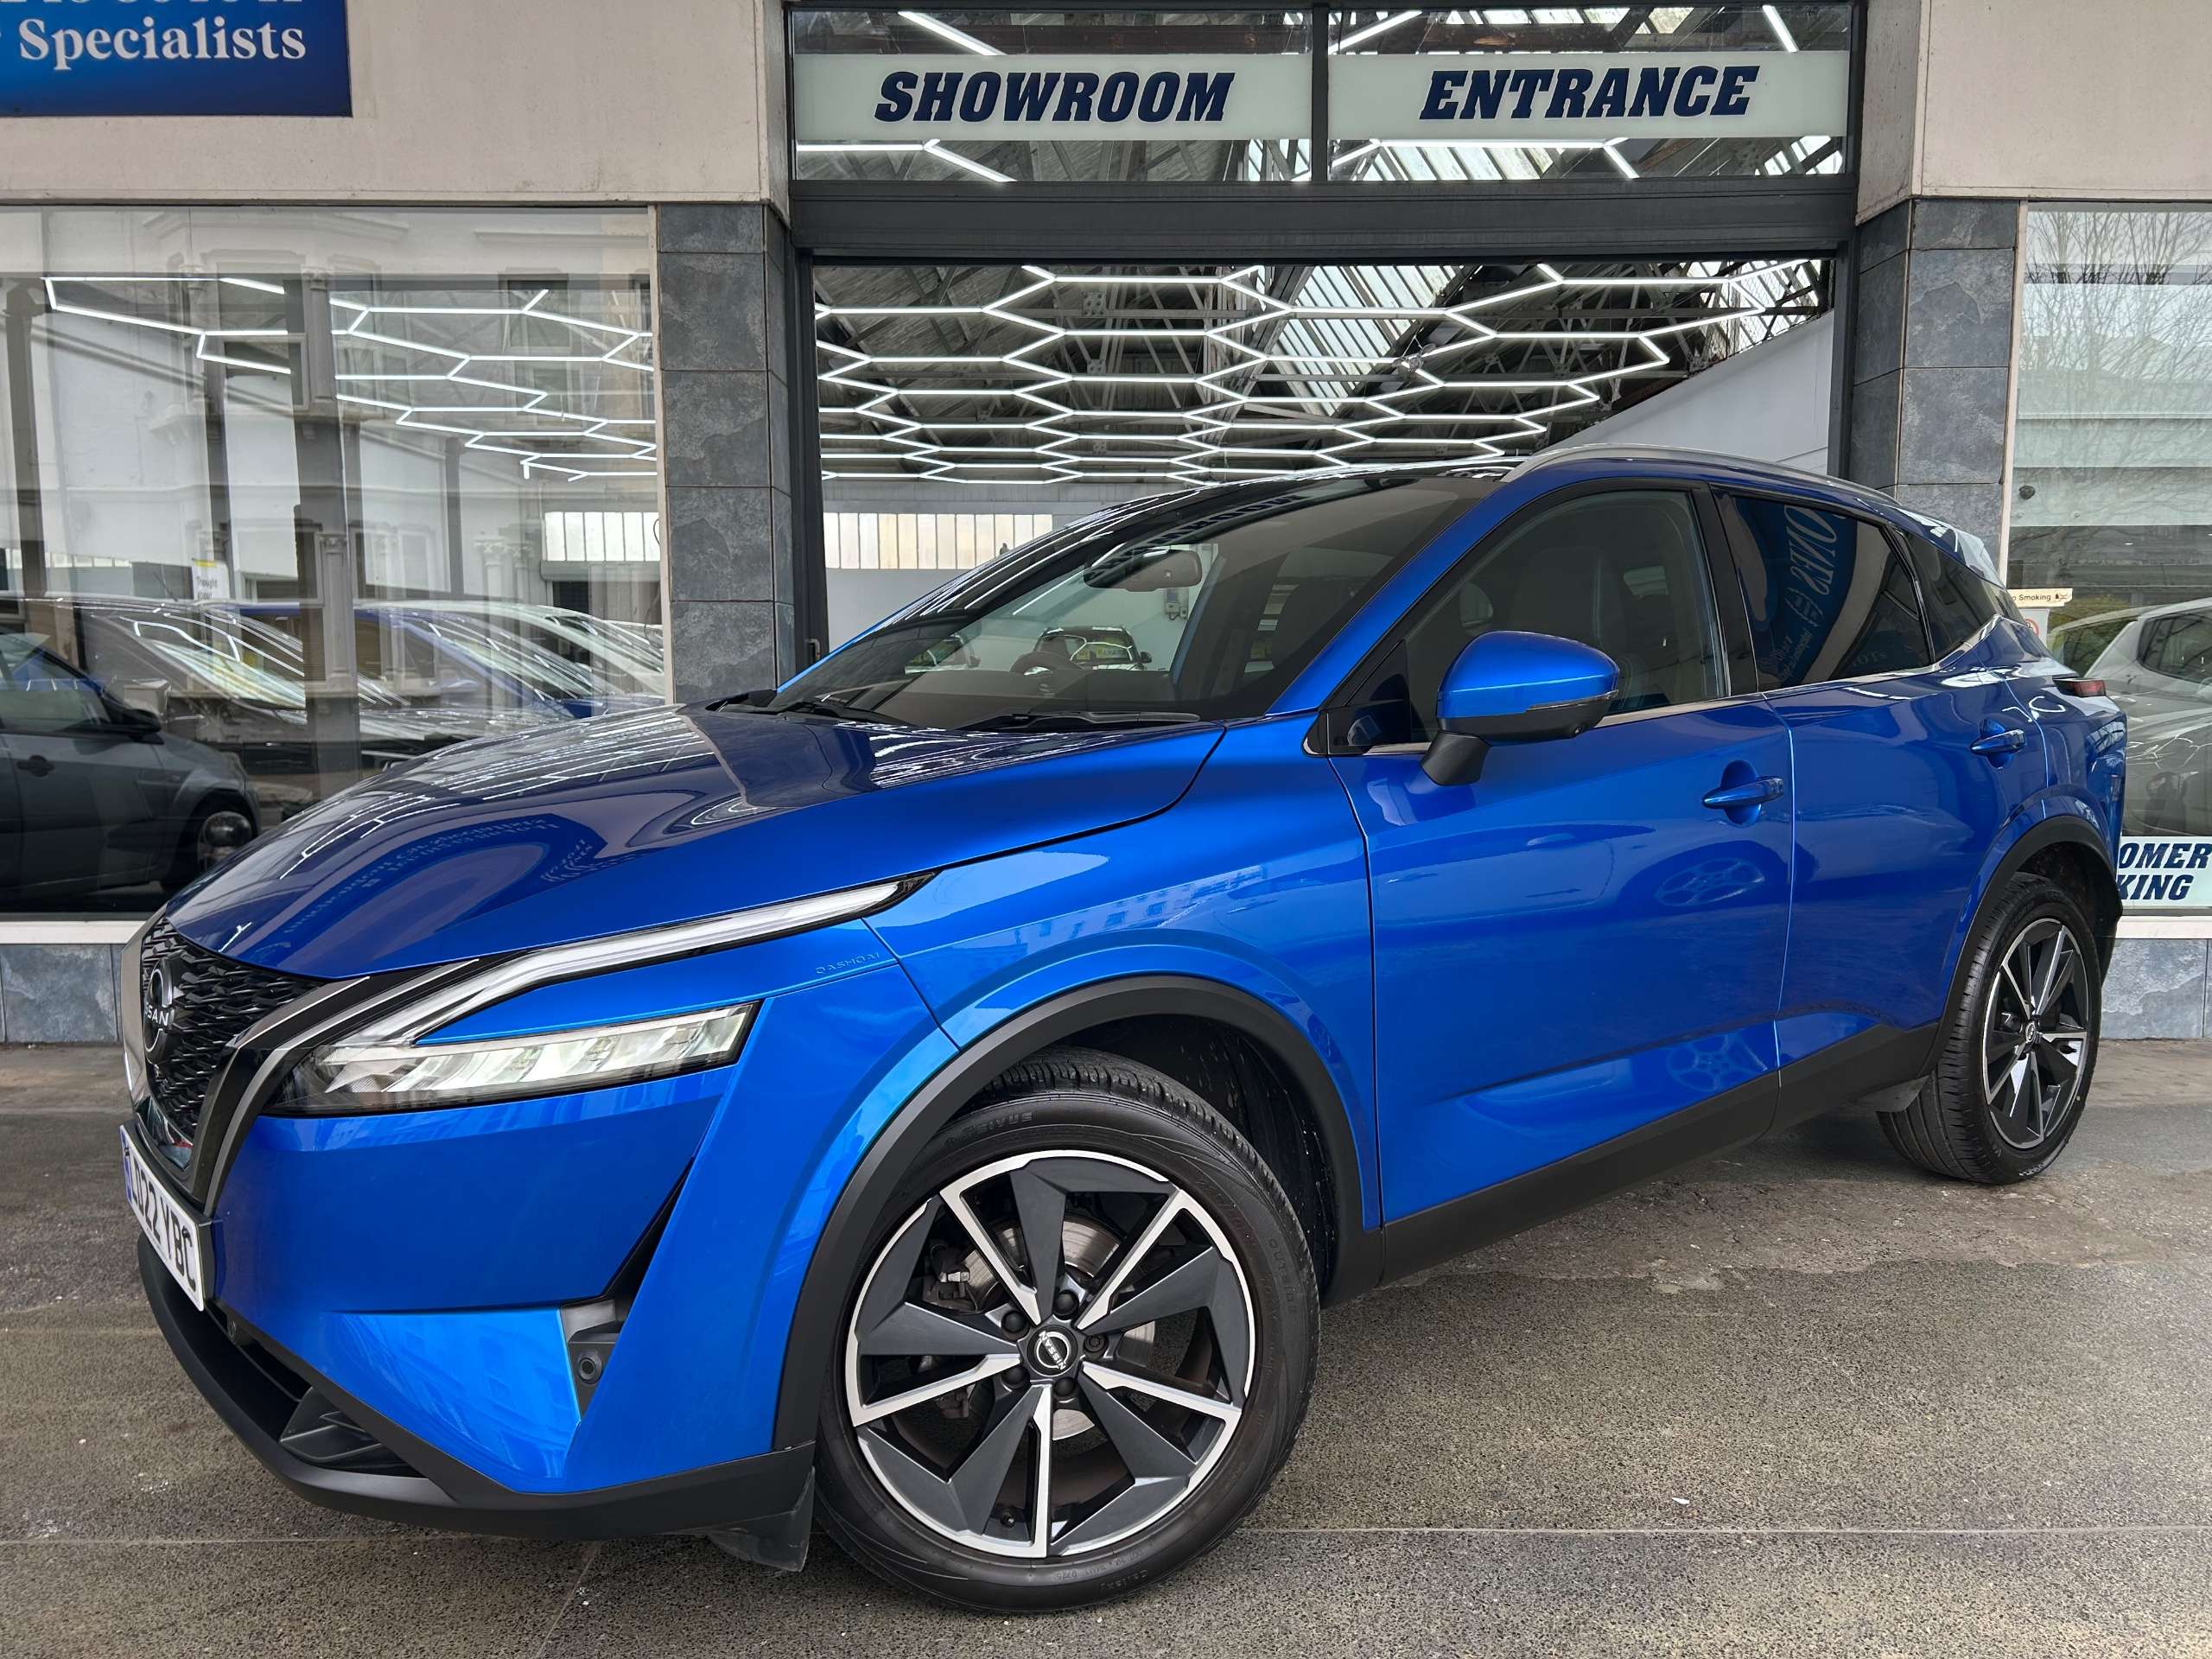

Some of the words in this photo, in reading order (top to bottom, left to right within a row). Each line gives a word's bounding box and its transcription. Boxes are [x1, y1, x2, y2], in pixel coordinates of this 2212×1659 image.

[19, 16, 306, 70] Specialists
[873, 71, 1236, 123] SHOWROOM
[1419, 65, 1761, 120] ENTRANCE
[2018, 594, 2051, 602] Smoking
[1039, 1331, 1066, 1370] NISSAN
